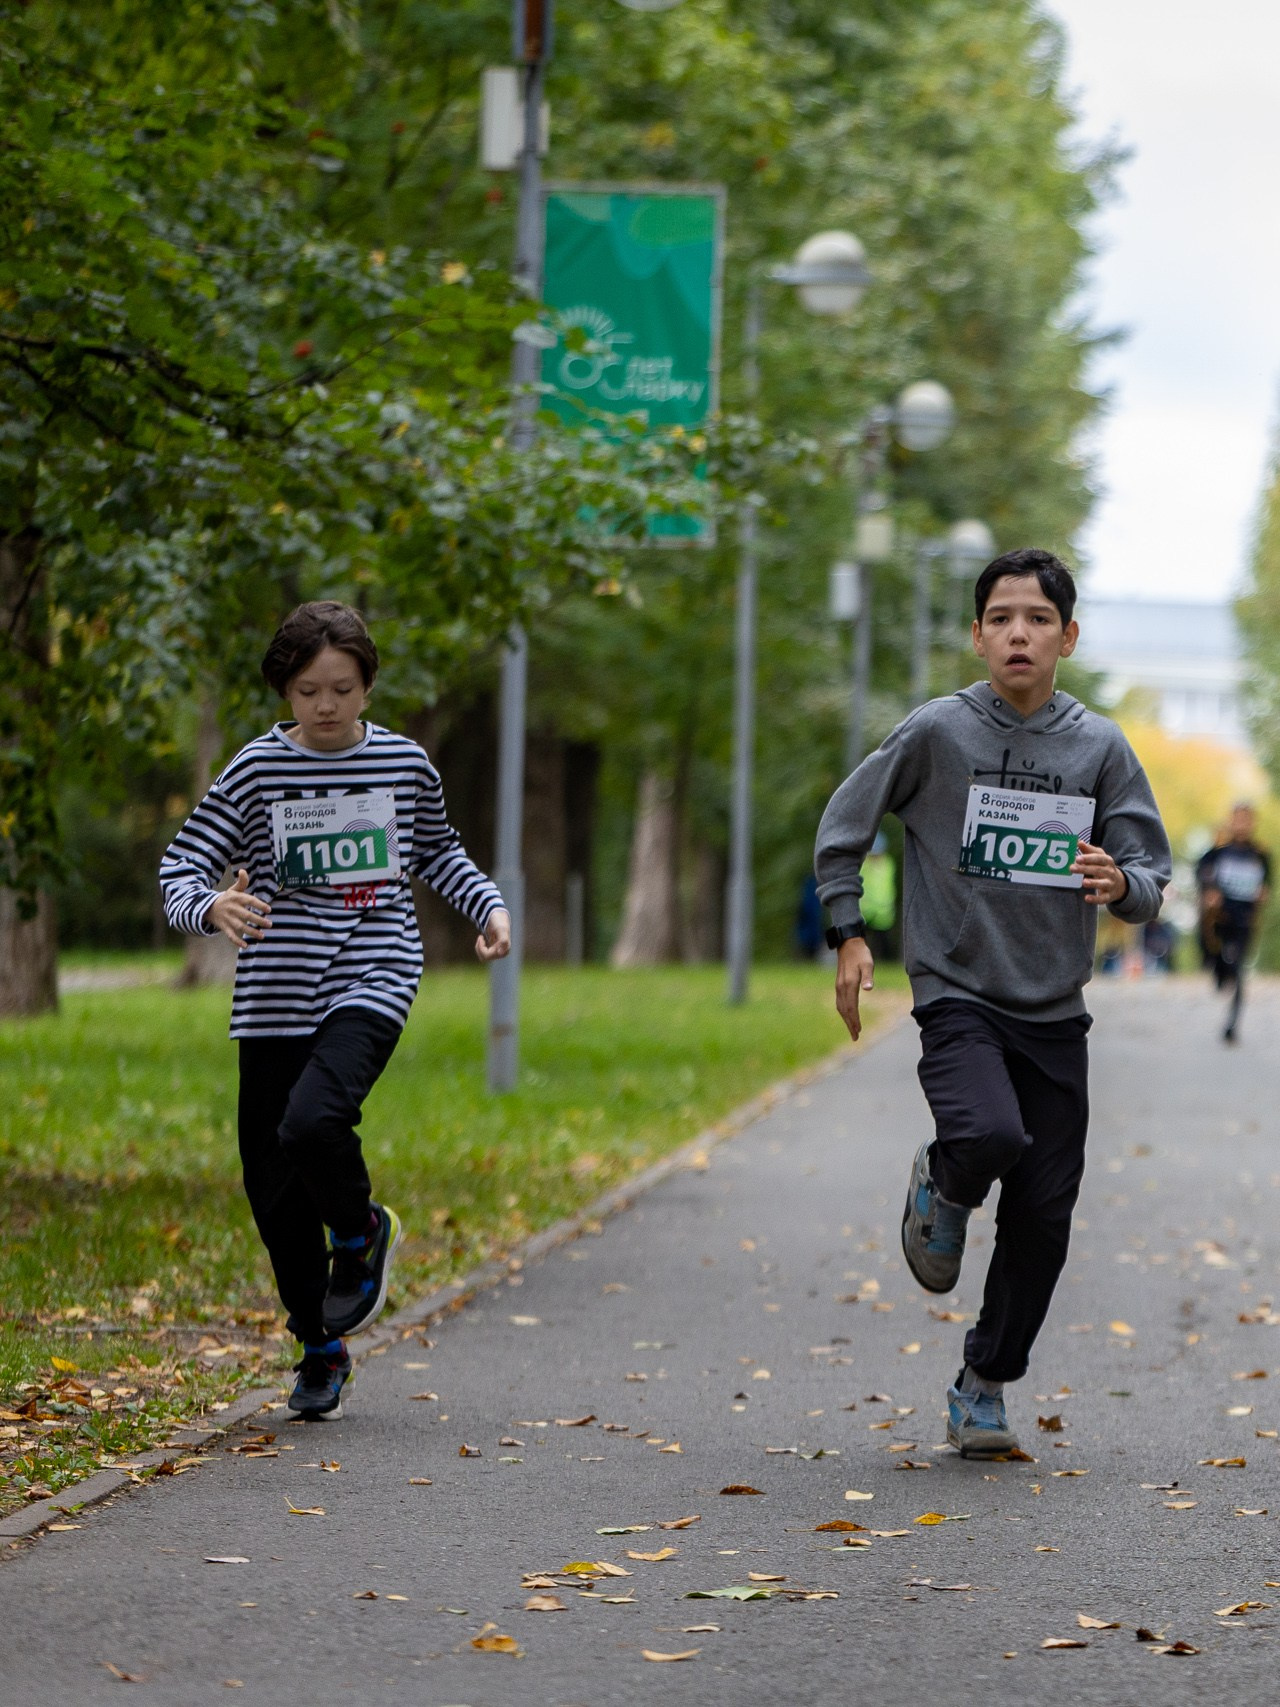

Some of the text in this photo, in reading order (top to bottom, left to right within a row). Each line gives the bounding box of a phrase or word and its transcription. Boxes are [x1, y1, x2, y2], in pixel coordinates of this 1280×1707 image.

[981, 793, 1034, 811] 8 городов
[284, 807, 336, 819] 8 городов
[979, 810, 1020, 822] КАЗАНЬ
[285, 821, 324, 831] КАЗАНЬ
[297, 836, 375, 870] 1101
[980, 832, 1069, 869] 1075
